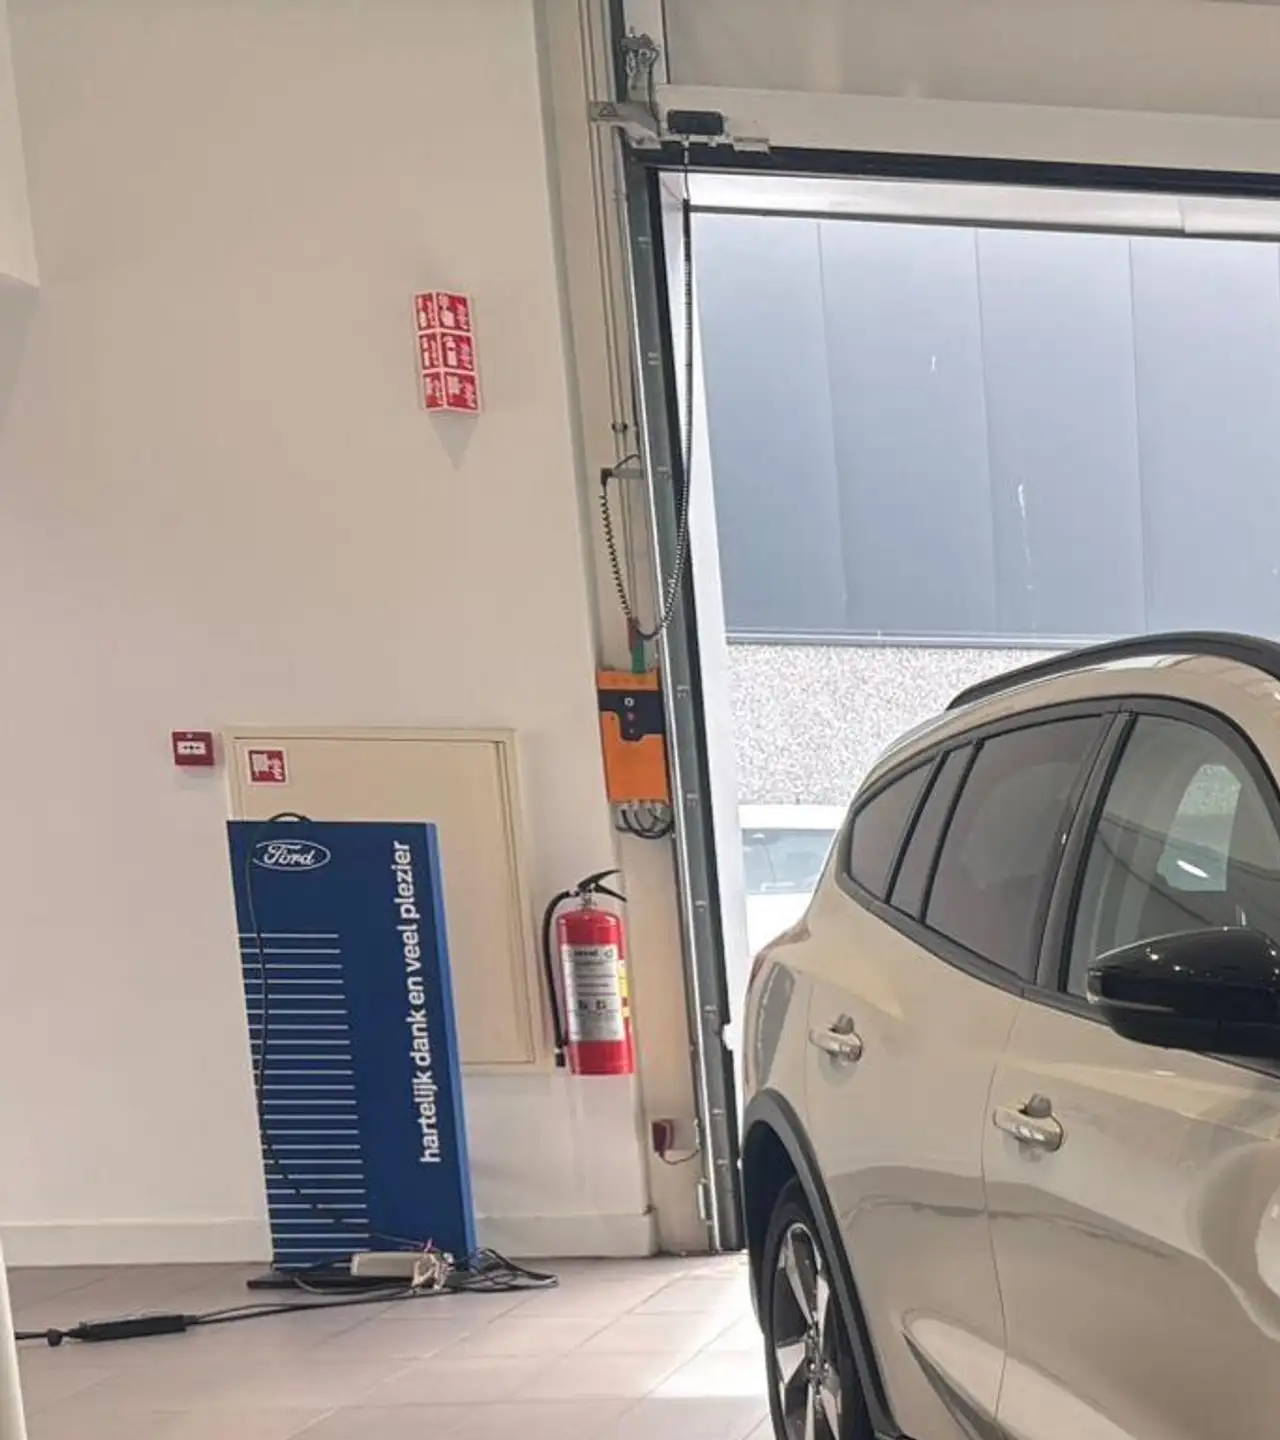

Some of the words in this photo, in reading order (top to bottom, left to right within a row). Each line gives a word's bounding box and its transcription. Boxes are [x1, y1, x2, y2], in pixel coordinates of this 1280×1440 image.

[263, 843, 316, 865] Ford
[390, 840, 421, 919] plezier
[396, 923, 422, 973] veel
[406, 976, 426, 1005] en
[405, 1008, 432, 1067] dank
[411, 1070, 442, 1163] hartelijk
